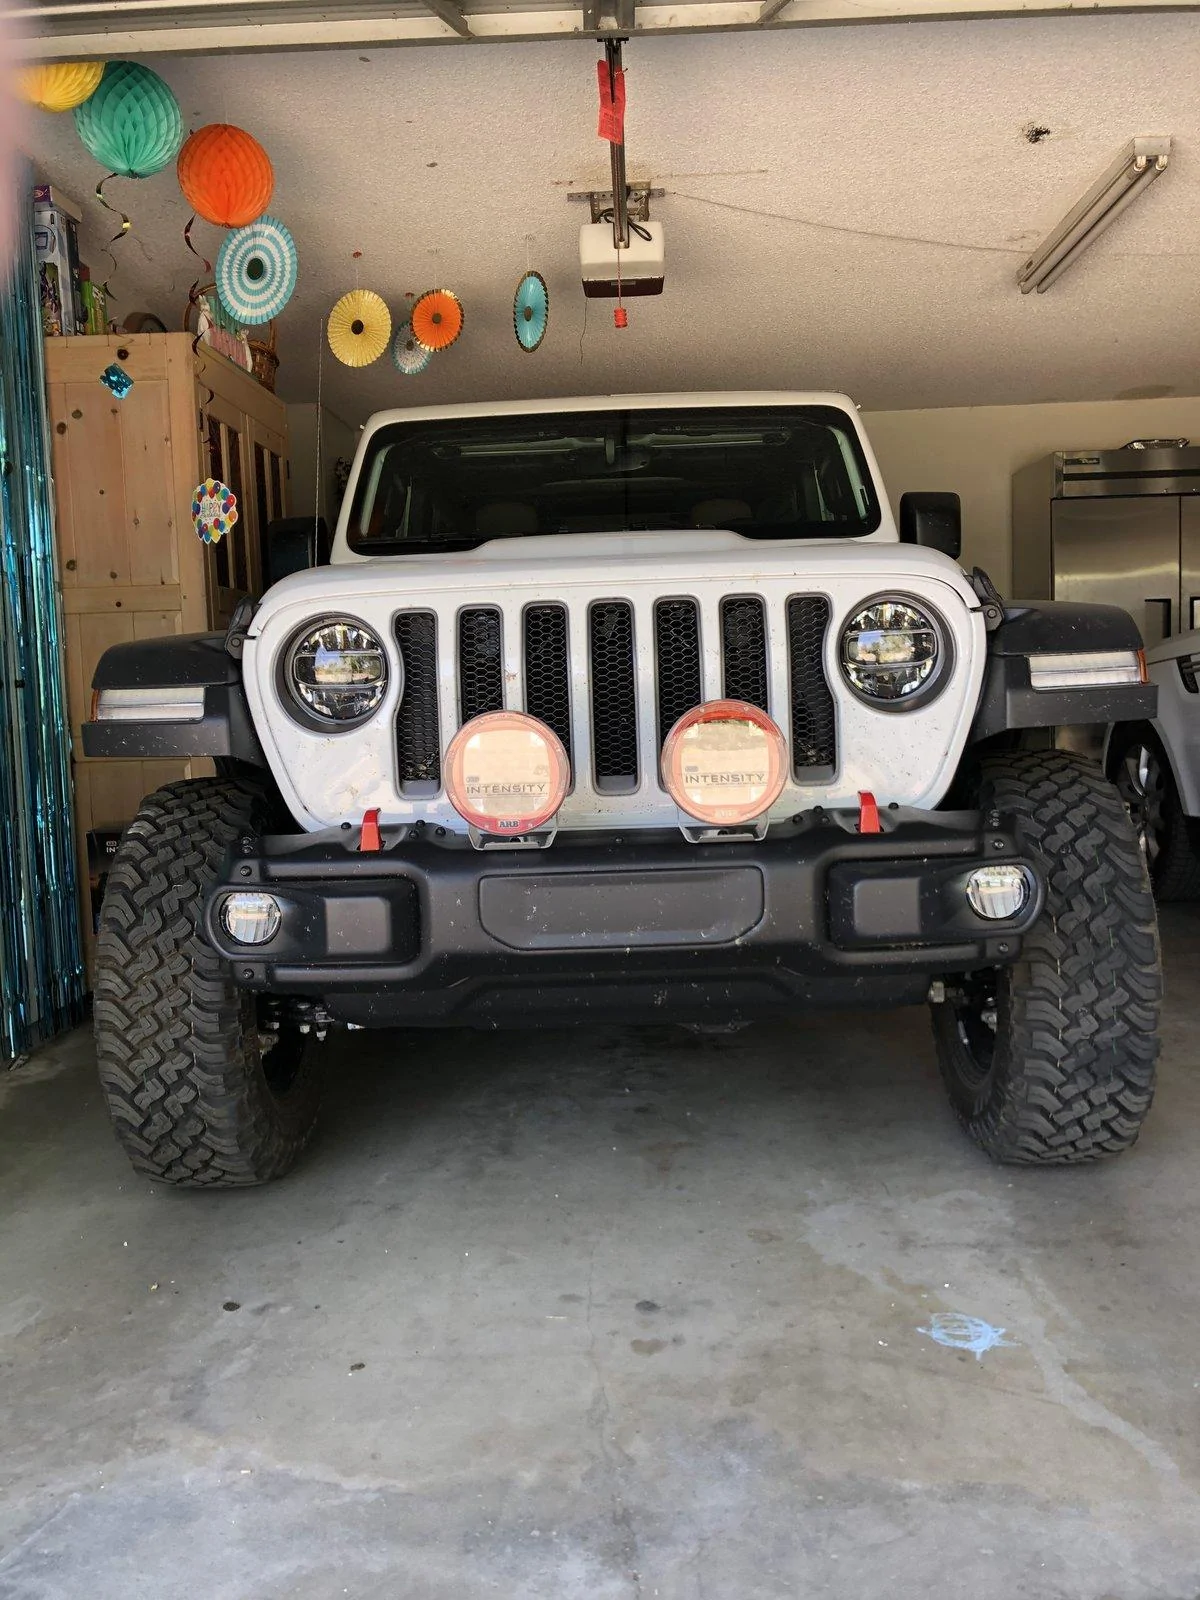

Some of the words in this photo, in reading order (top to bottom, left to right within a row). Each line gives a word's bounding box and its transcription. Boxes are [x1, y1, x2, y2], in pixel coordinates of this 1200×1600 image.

[685, 773, 765, 784] INTENSITY
[466, 783, 545, 794] INTENSITY
[499, 820, 519, 828] ARB
